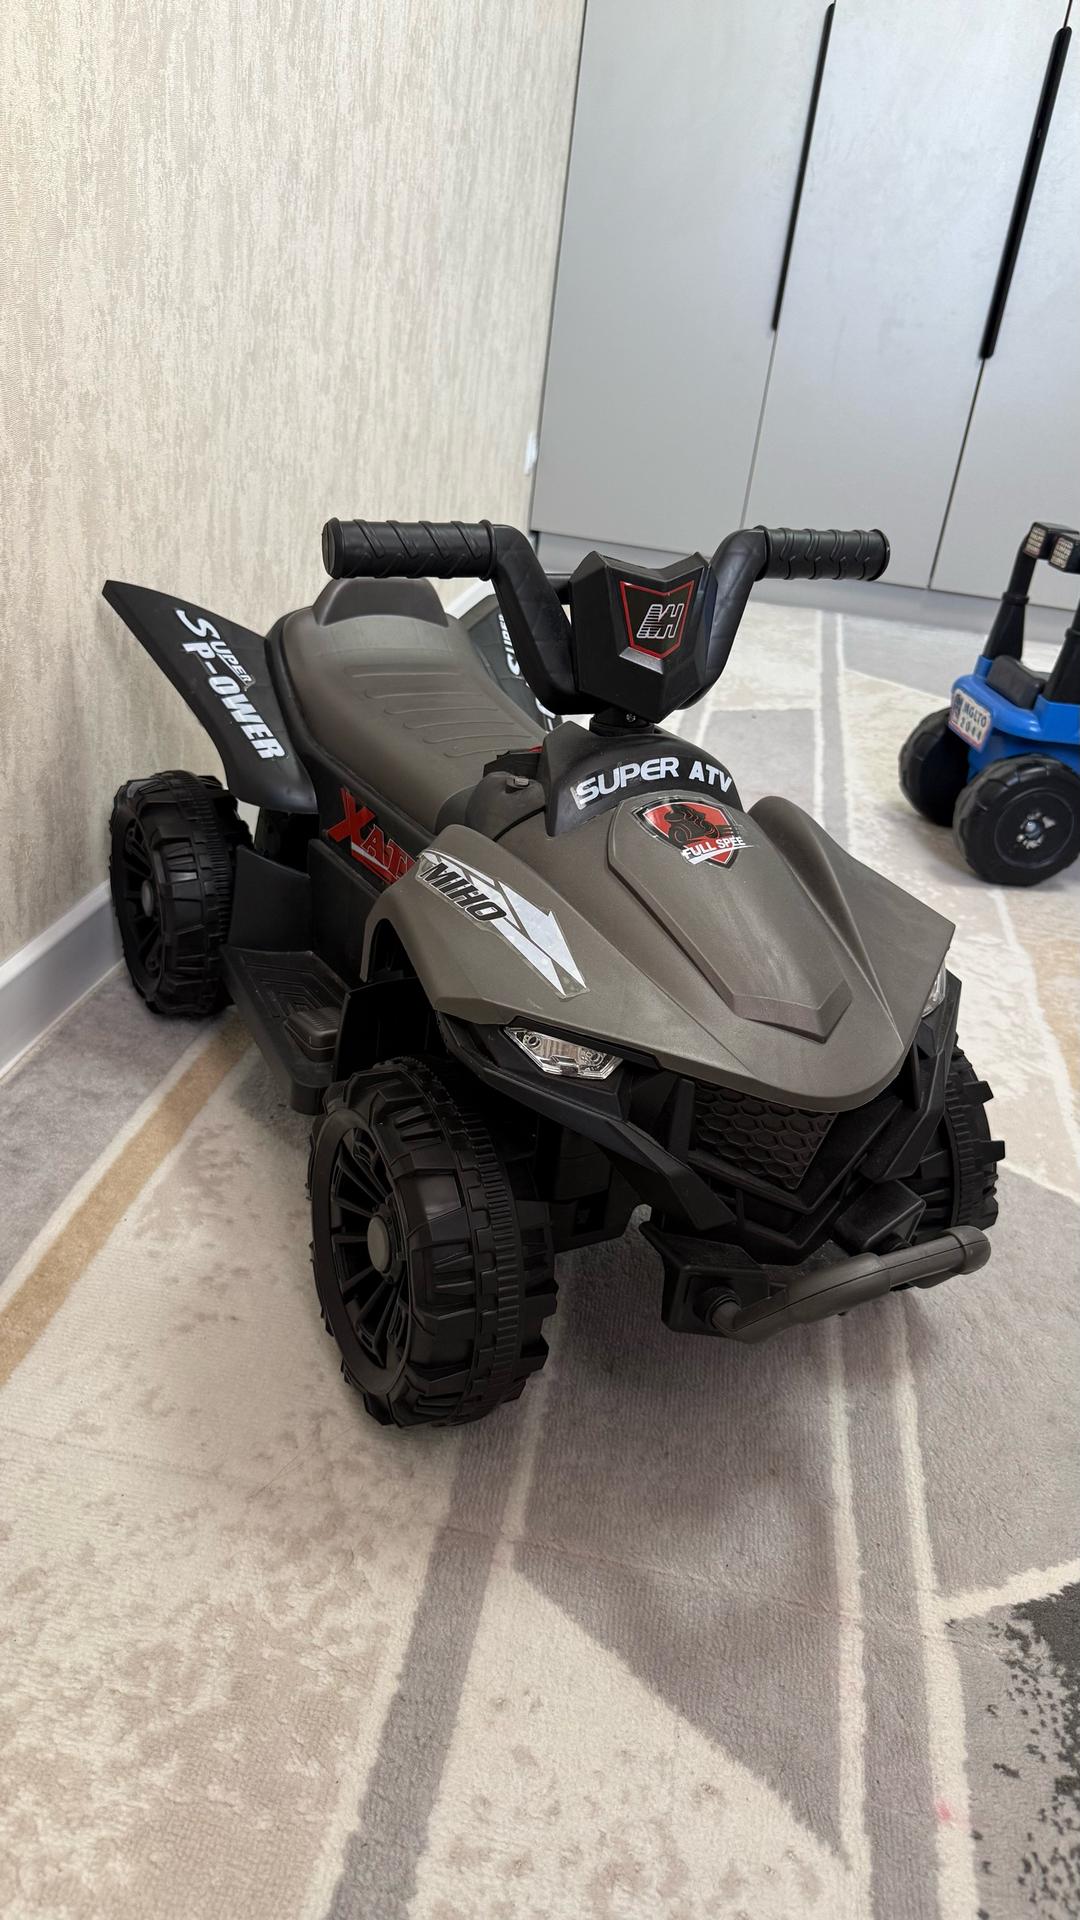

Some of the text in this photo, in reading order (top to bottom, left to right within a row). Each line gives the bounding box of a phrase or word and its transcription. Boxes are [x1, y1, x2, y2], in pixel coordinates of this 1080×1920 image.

[175, 609, 253, 686] SUPER
[182, 640, 286, 760] P-OWER
[574, 756, 733, 807] SUPER ATV
[681, 841, 717, 860] FULL
[419, 862, 507, 922] MIHO
